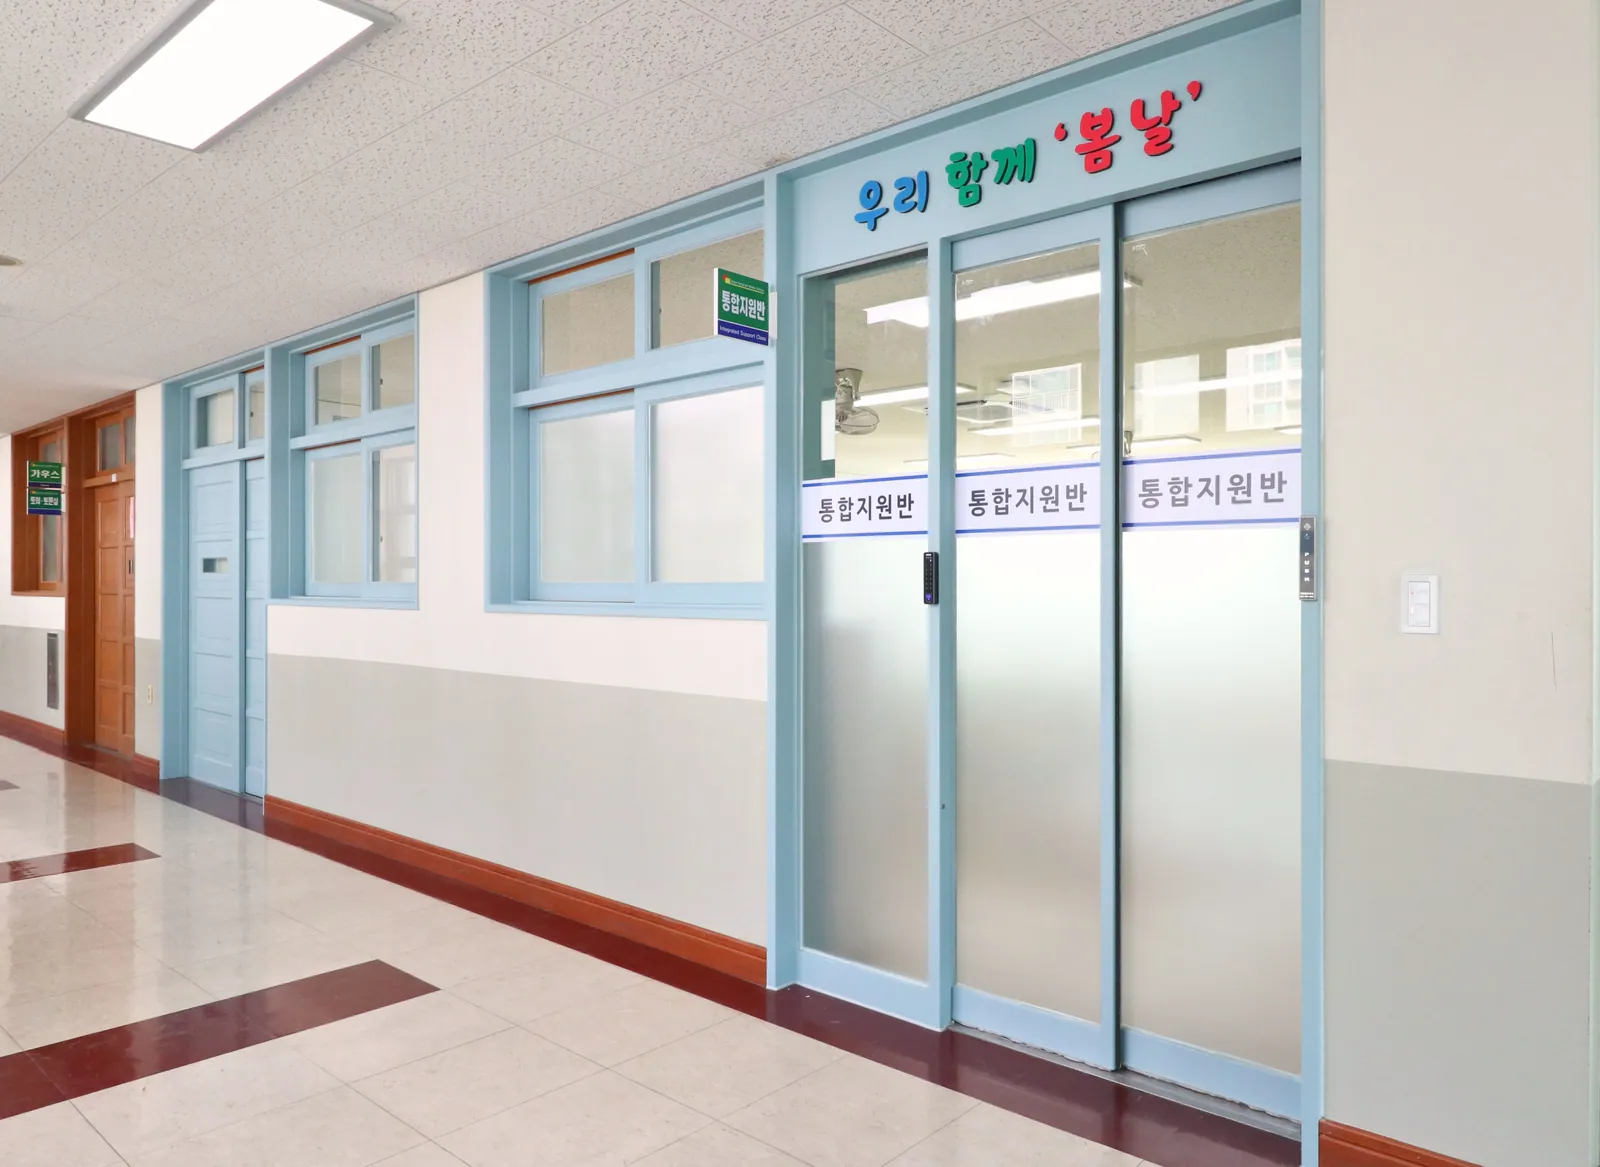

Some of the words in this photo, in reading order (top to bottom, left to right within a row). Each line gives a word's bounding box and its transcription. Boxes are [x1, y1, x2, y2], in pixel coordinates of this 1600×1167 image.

[854, 170, 930, 232] 우리
[946, 137, 1038, 207] 함께
[721, 289, 766, 321] 통합지원반
[740, 330, 756, 339] Support
[30, 469, 60, 479] 가우스
[1137, 470, 1288, 509] 통합지원반
[817, 492, 915, 524] 통합지원반
[967, 481, 1089, 517] 통합지원반
